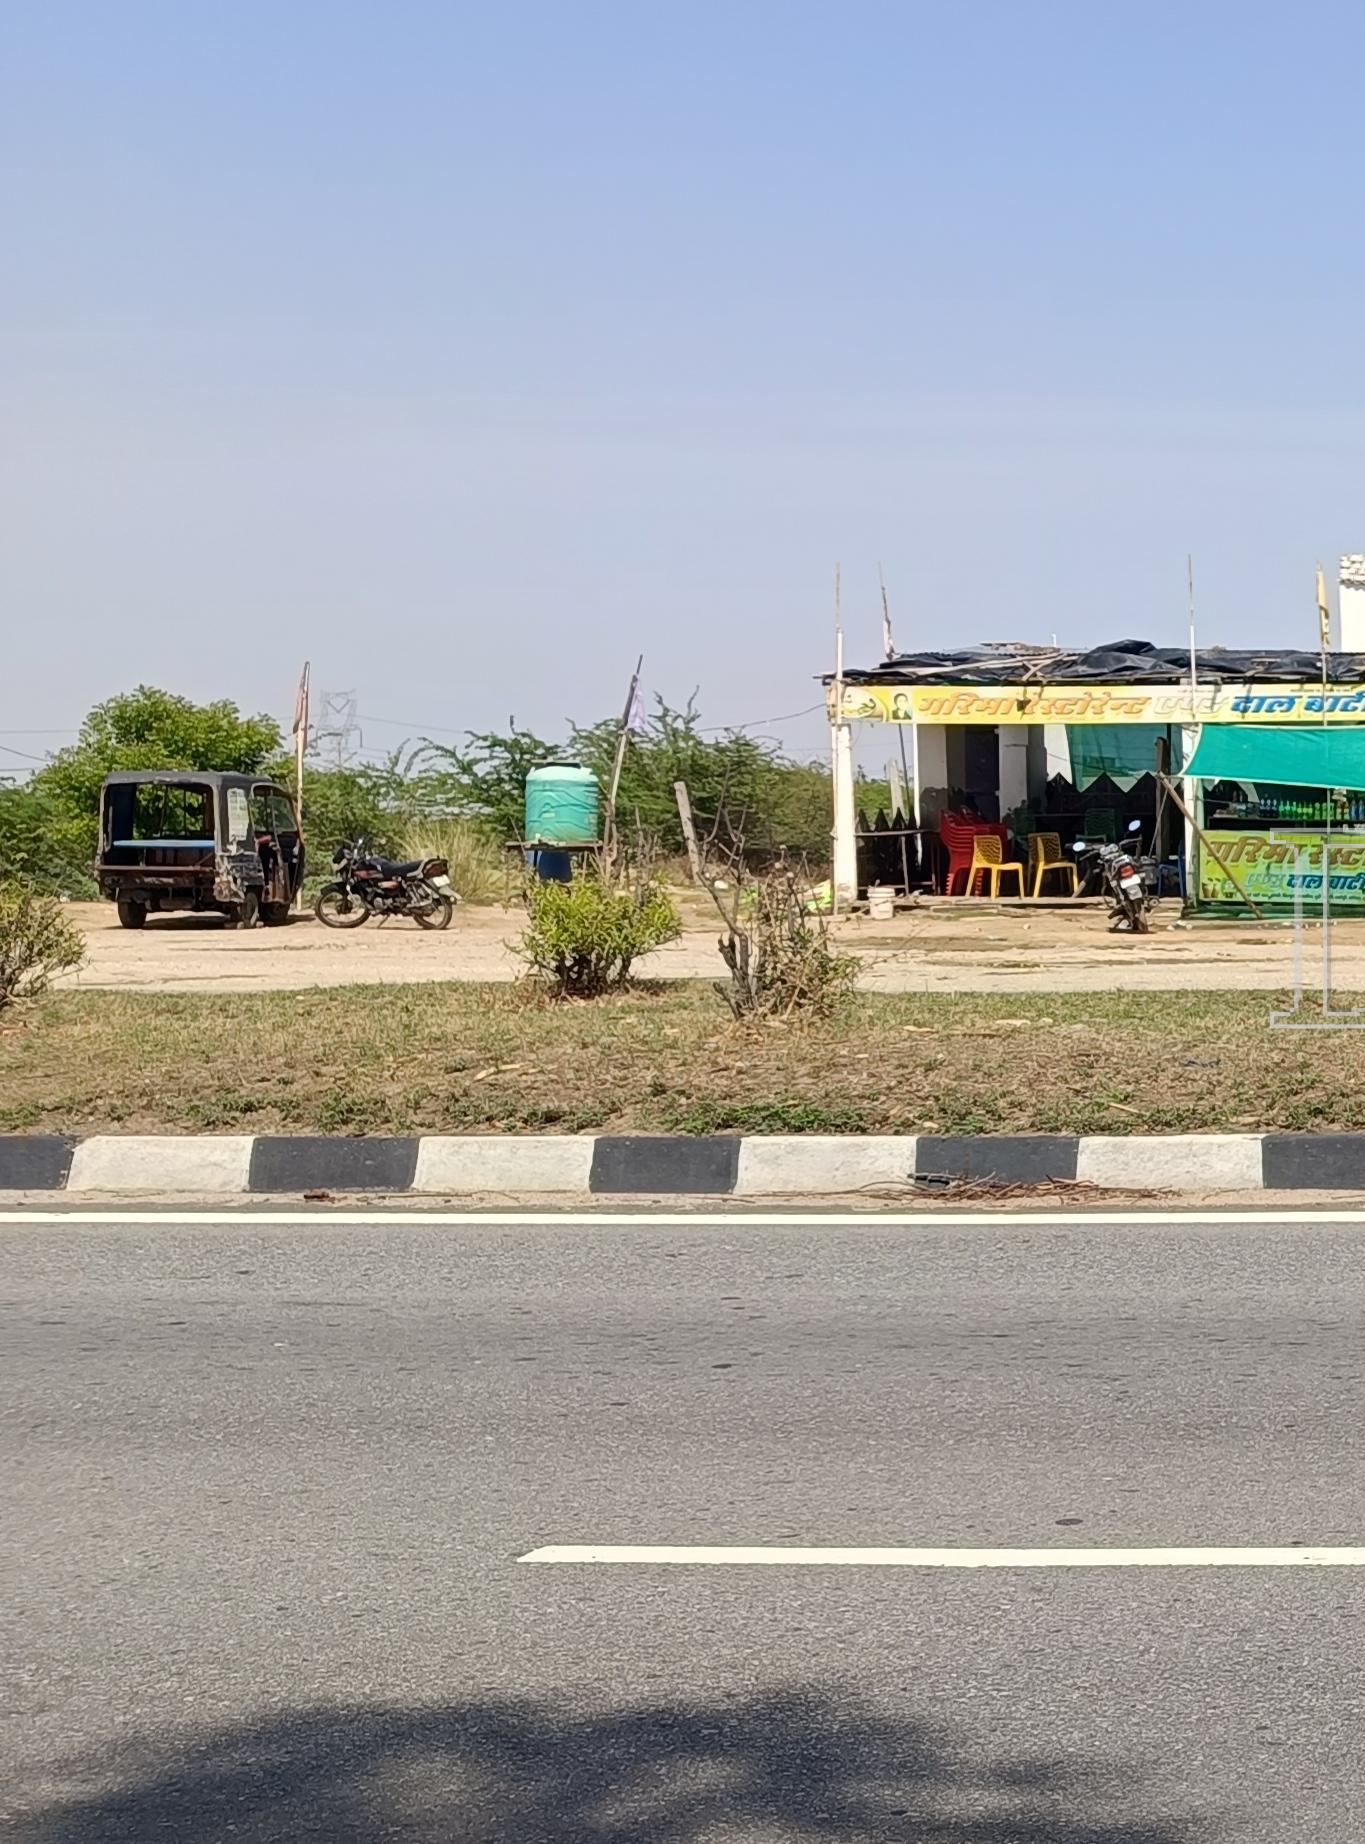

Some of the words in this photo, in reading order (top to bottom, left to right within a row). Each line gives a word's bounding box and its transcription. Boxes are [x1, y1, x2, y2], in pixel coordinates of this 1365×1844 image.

[919, 692, 1014, 715] गरिमा
[1231, 695, 1300, 713] दाल
[1208, 836, 1303, 864] गरिमा
[1286, 873, 1325, 889] दाल
